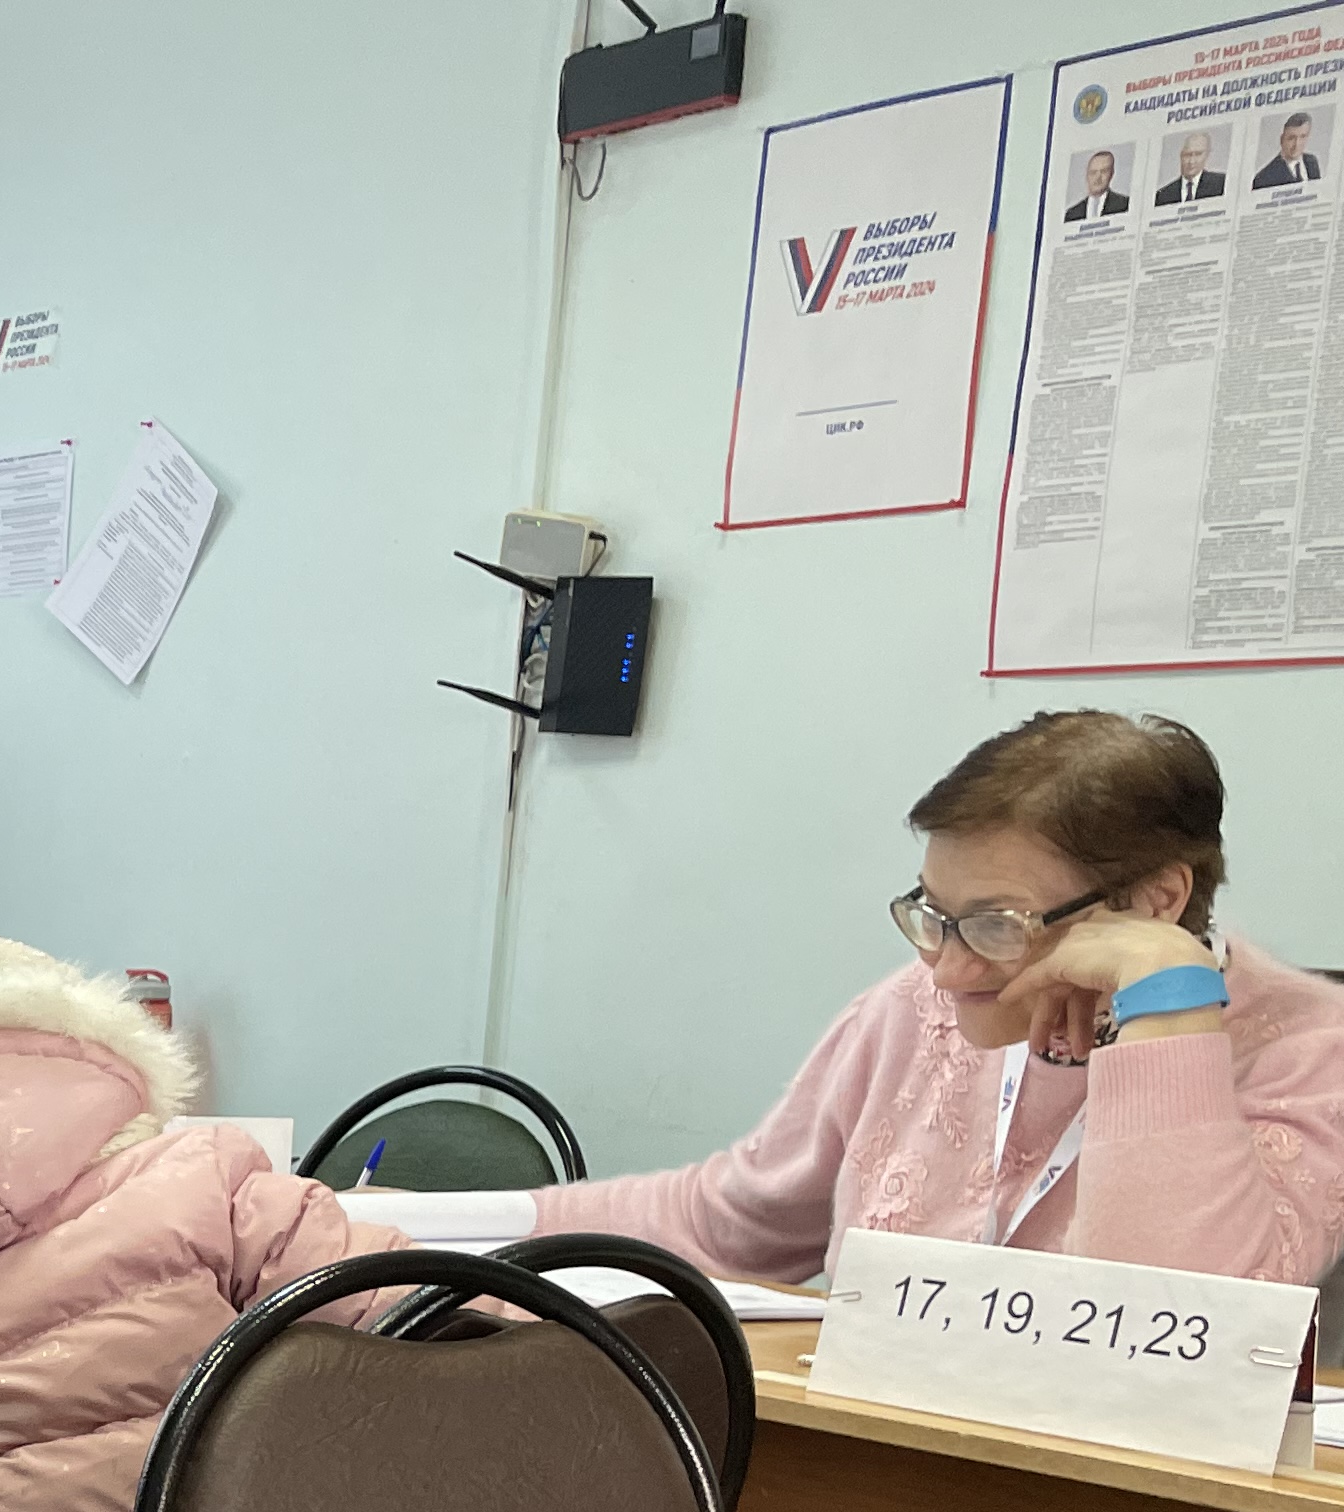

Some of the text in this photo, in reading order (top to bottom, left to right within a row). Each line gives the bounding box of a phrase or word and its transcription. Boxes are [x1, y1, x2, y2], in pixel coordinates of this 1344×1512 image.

[1124, 87, 1200, 114] КАНДИДАТЫ
[1202, 84, 1218, 99] НА
[1220, 68, 1301, 97] ДОЛЖНОСТЬ
[1125, 72, 1173, 94] ВЫБОРЫ
[1173, 59, 1243, 84] ПРЕЗИДЕНТА
[1166, 78, 1337, 124] РОССИЙСКОЙ ФЕДЕРАЦИИ
[863, 211, 938, 242] ВЫБОРЫ
[853, 231, 957, 266] ПРЕЗИДЕНТА
[843, 263, 908, 290] РОССИИ
[865, 284, 906, 305] МАРТА
[893, 1275, 953, 1331] 17,
[980, 1287, 1043, 1345] 19,
